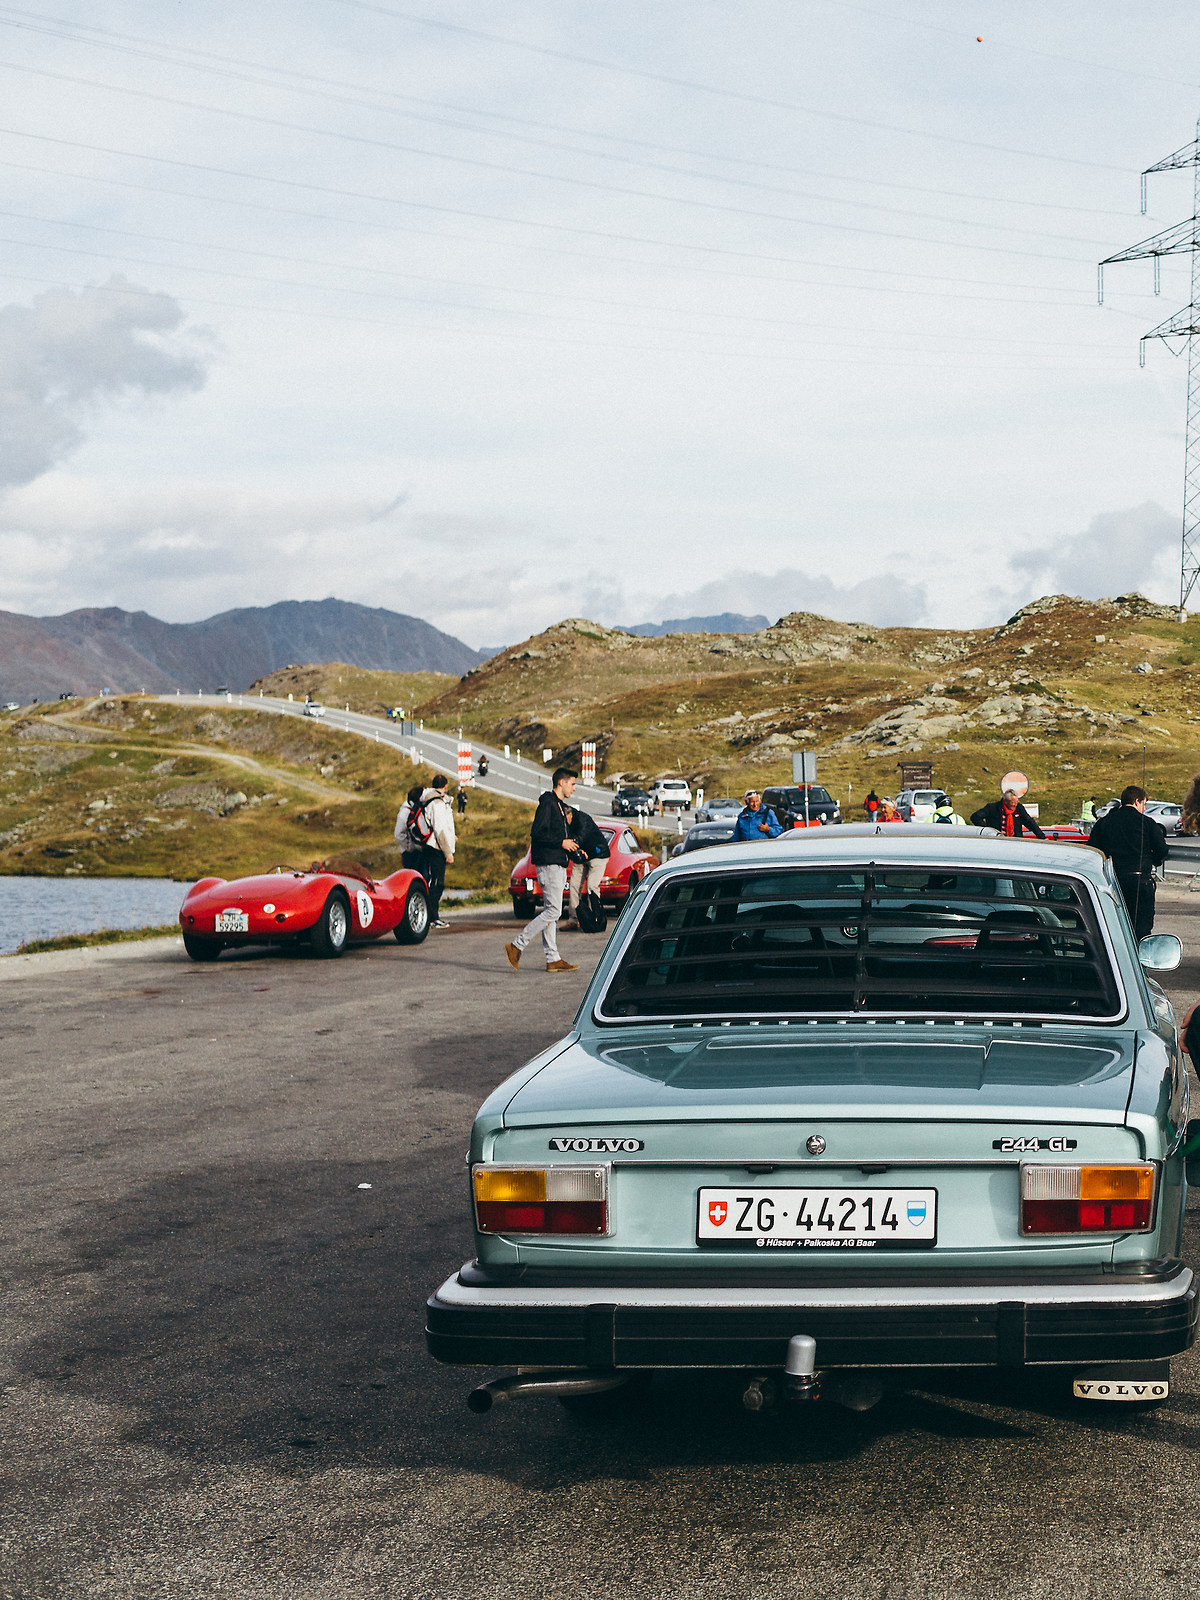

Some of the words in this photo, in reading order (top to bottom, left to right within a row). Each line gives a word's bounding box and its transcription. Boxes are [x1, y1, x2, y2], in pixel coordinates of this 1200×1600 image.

[552, 1138, 640, 1152] VOLVO
[1001, 1137, 1040, 1152] 244
[1049, 1137, 1073, 1152] GL
[841, 1239, 855, 1247] AG
[856, 1239, 877, 1247] Baar
[1077, 1384, 1165, 1395] VOLVO
